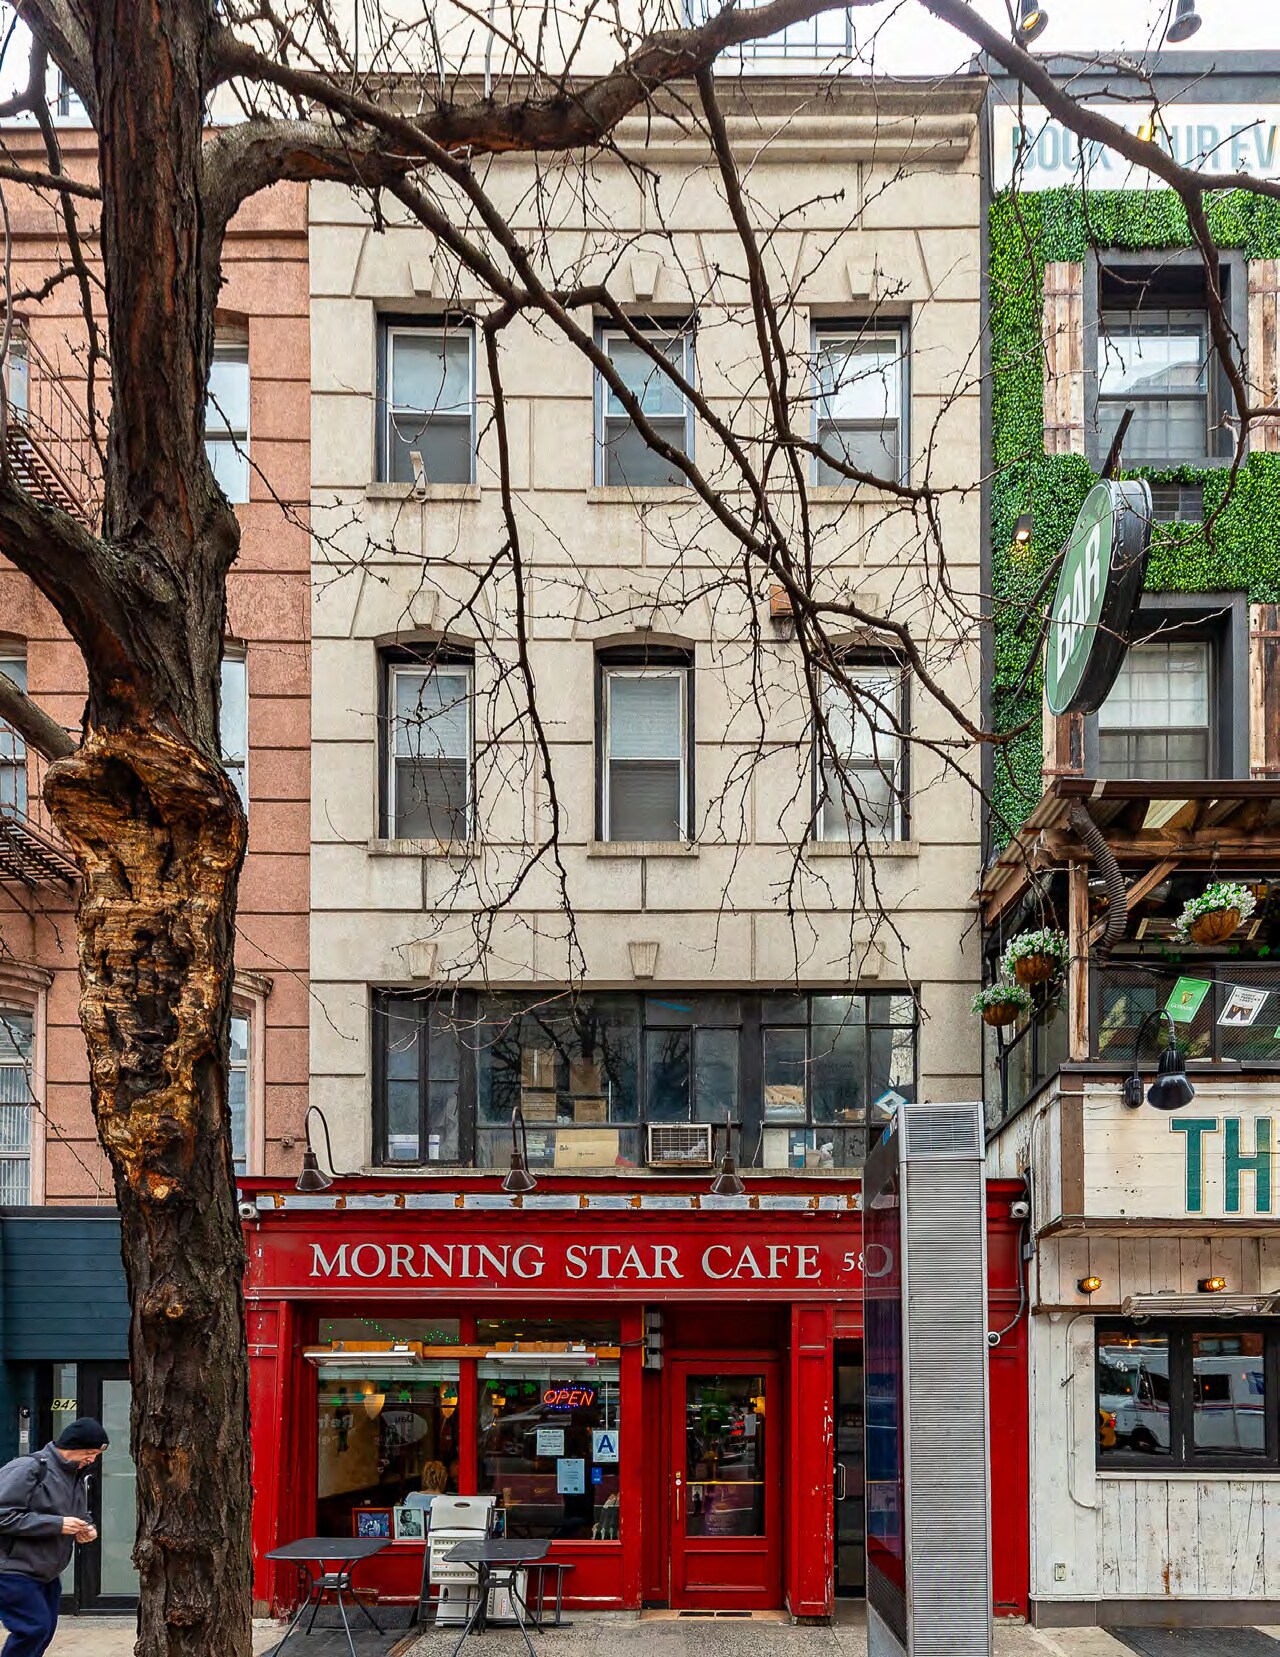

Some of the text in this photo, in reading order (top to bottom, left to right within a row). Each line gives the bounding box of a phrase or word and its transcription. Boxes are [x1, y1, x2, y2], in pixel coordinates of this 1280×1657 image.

[1057, 522, 1101, 684] BAR
[309, 1242, 546, 1279] MORNING
[565, 1242, 684, 1279] STAR
[701, 1242, 822, 1279] CAFE
[52, 1399, 78, 1410] 947
[543, 1390, 594, 1406] OPEN
[597, 1434, 615, 1453] A
